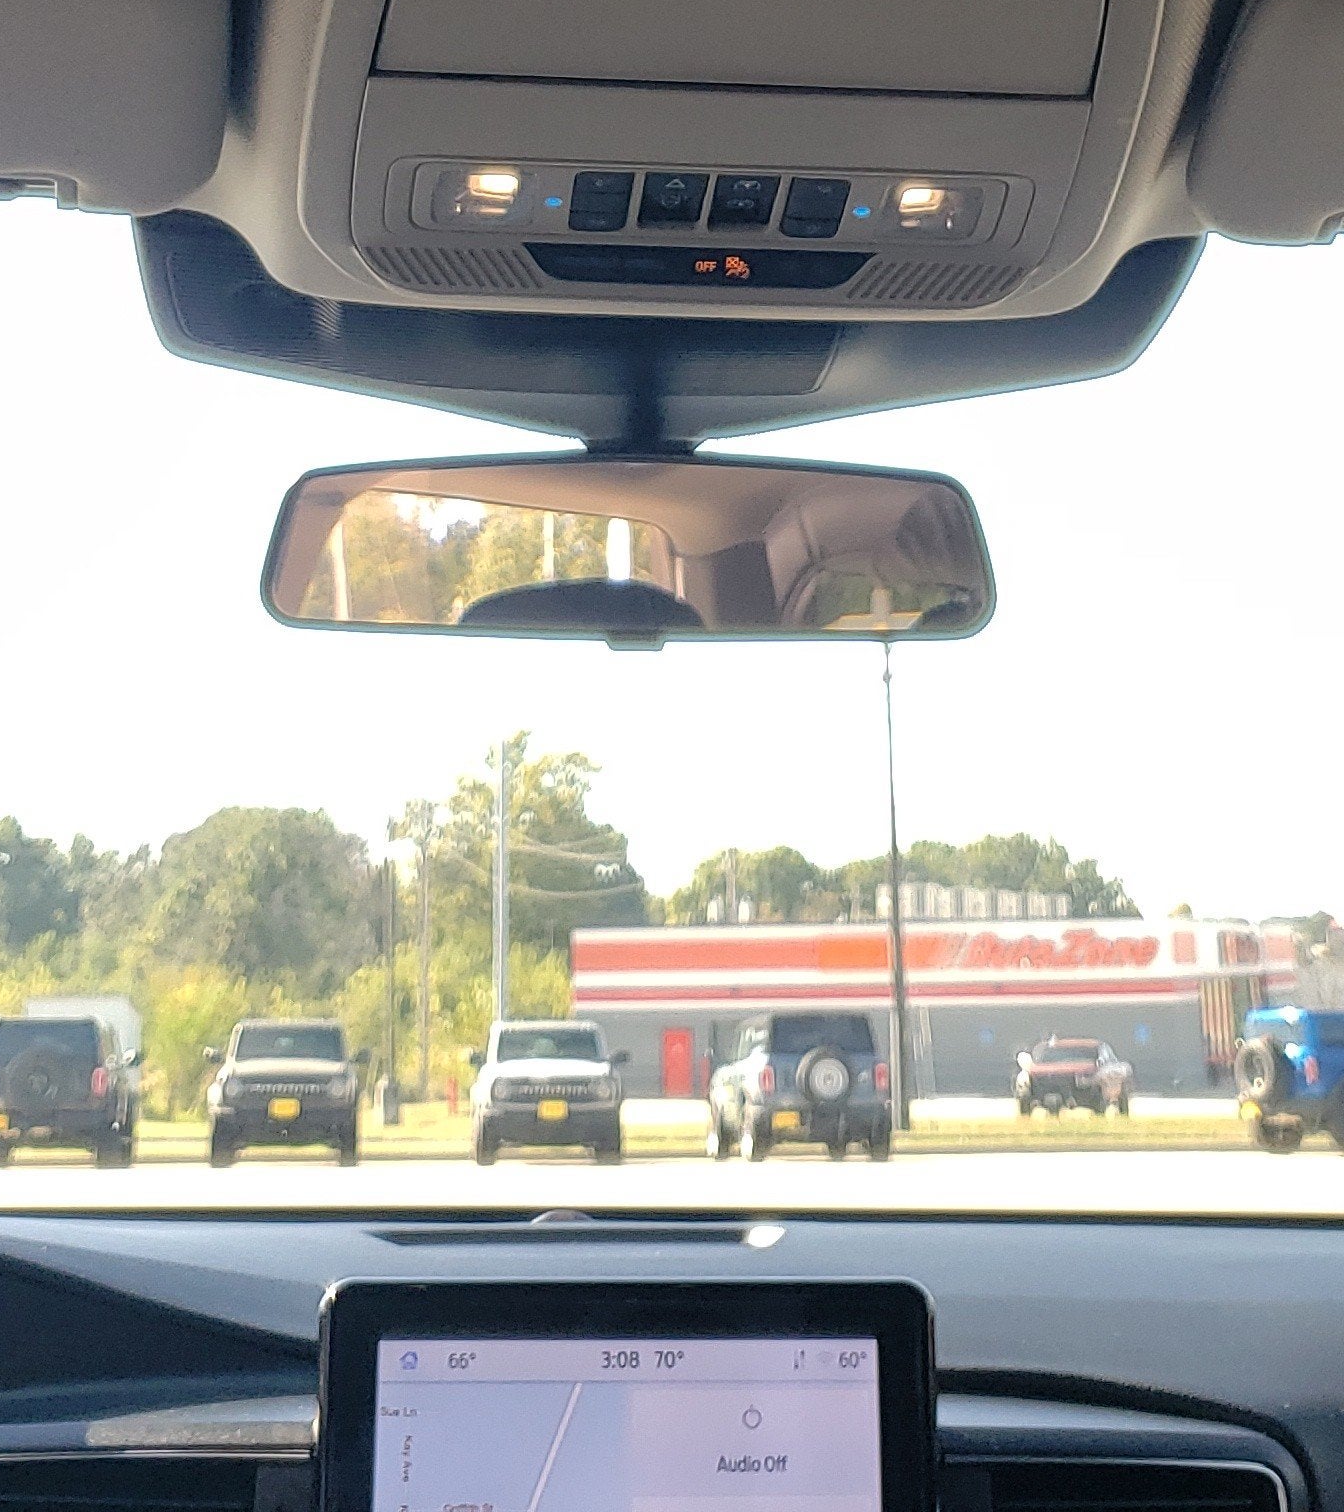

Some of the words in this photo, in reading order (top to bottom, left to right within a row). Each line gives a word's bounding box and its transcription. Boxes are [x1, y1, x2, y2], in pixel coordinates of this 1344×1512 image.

[694, 260, 717, 274] OFF
[447, 1351, 476, 1369] 66°
[601, 1350, 640, 1369] 3:08
[654, 1350, 684, 1369] 70°
[716, 1455, 759, 1473] Audio
[763, 1455, 788, 1473] Off
